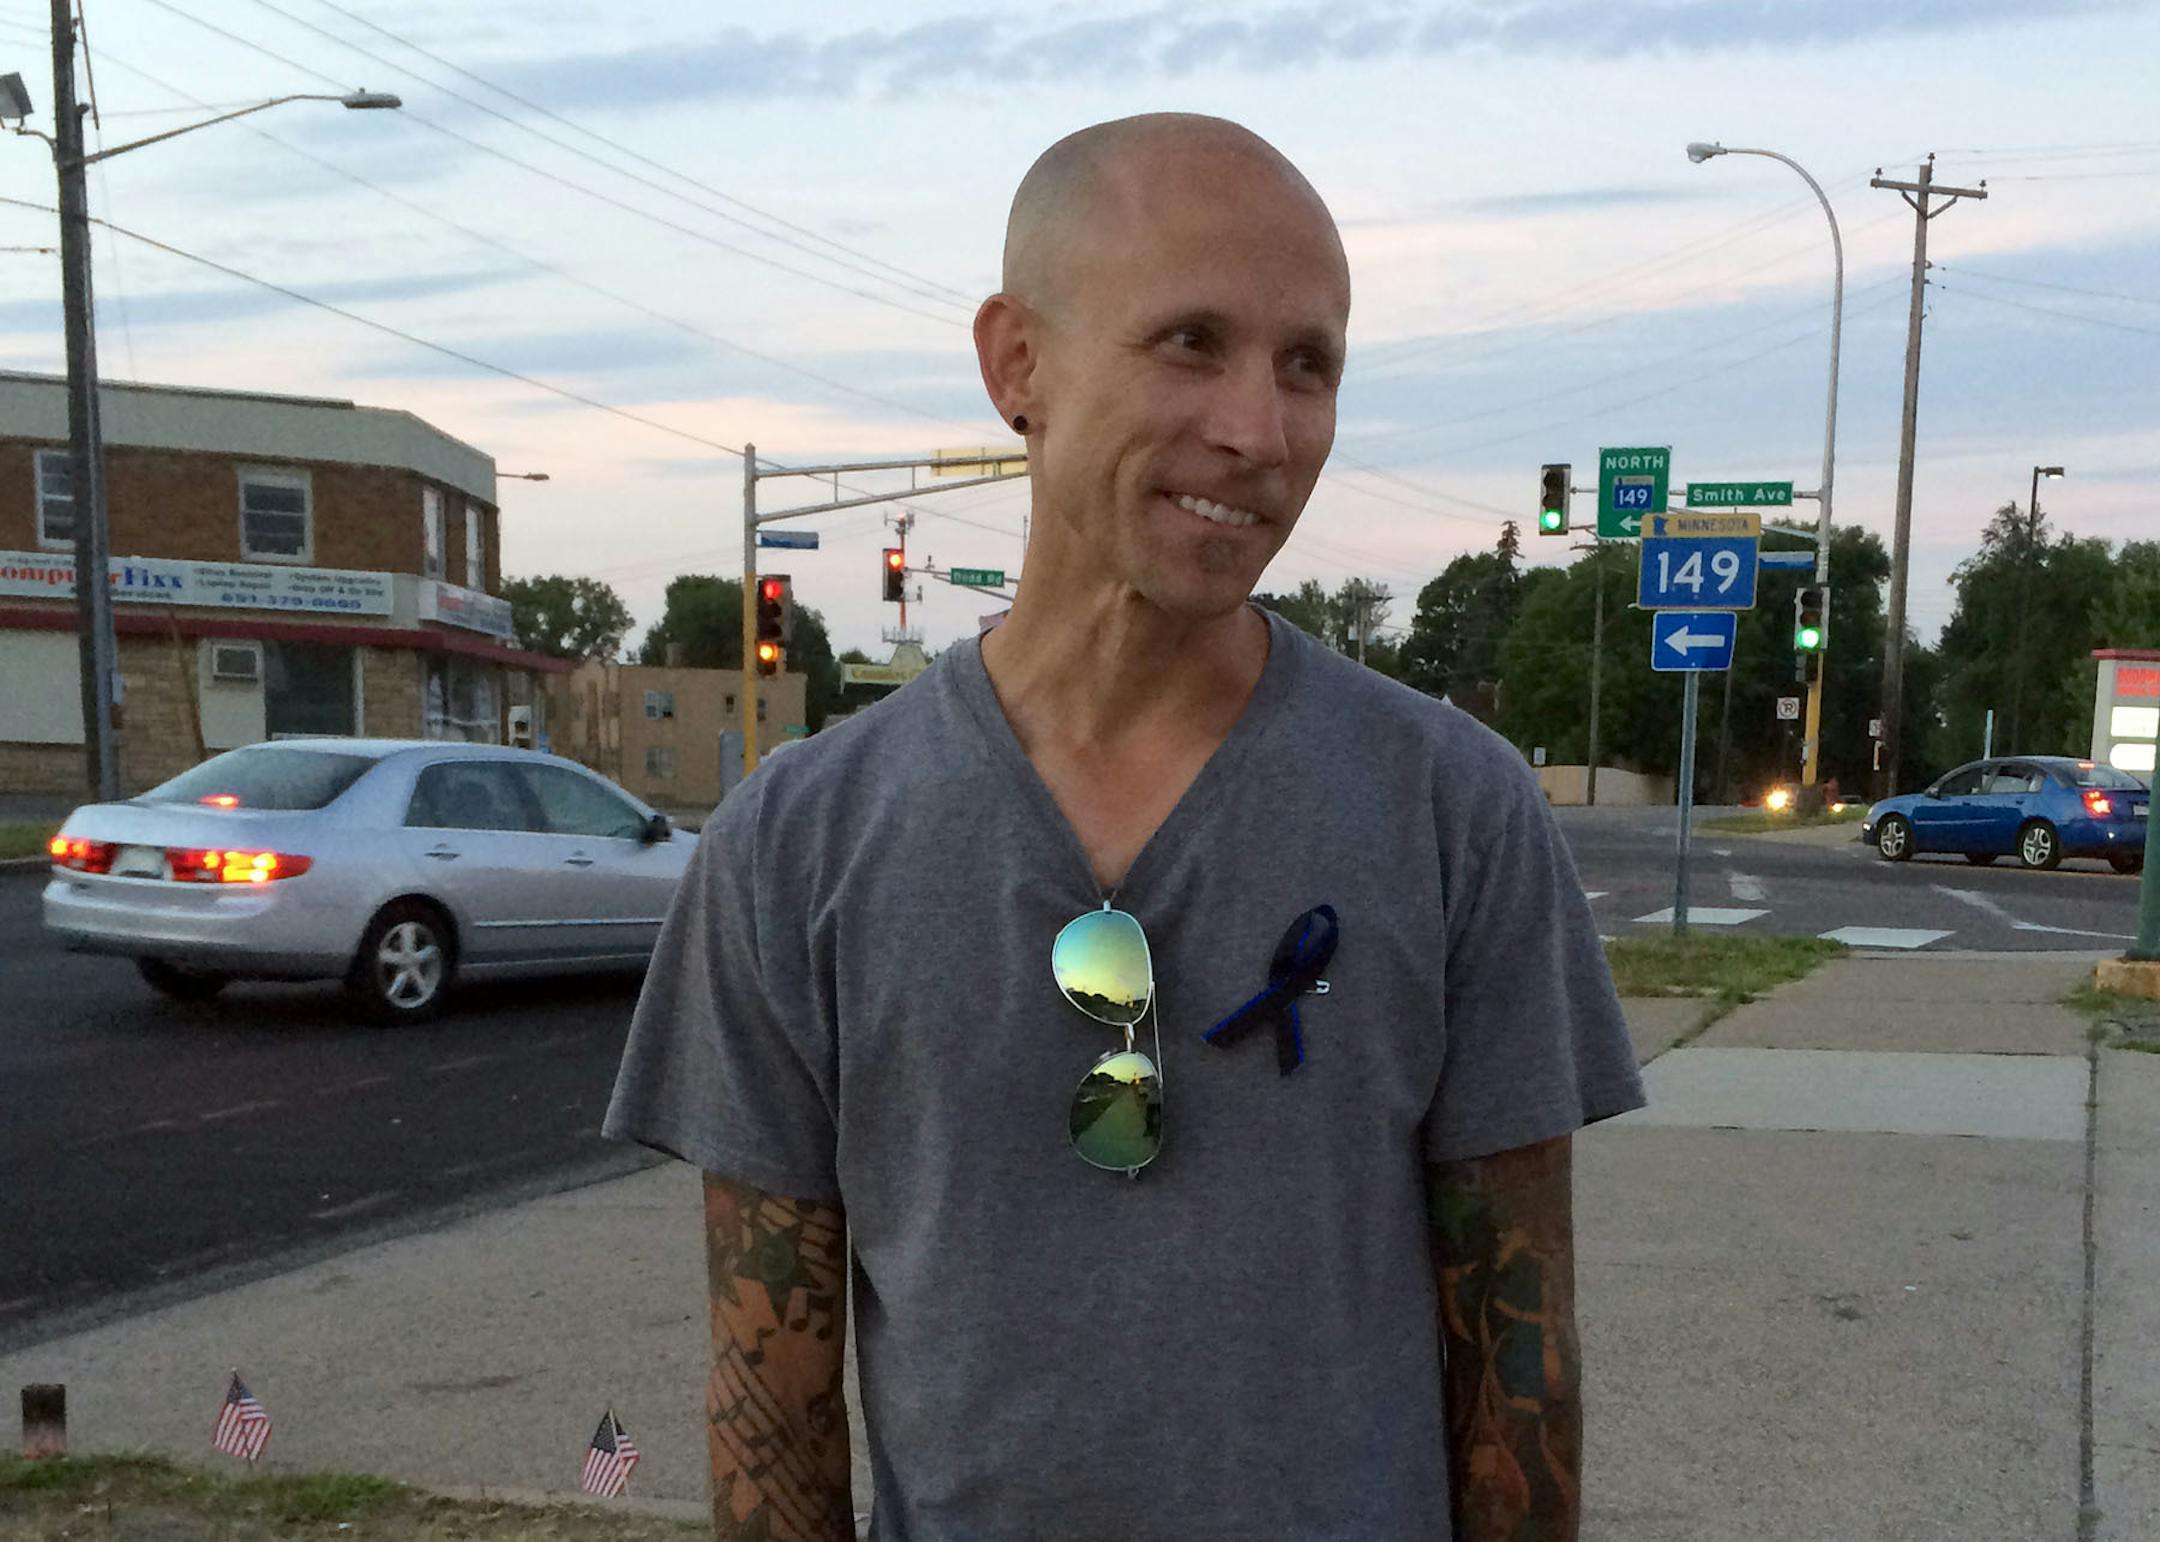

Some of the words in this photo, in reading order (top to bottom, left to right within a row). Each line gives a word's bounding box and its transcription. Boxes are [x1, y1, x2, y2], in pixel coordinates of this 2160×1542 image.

[1605, 455, 1664, 470] NORTH
[1619, 488, 1648, 505] 149
[1692, 488, 1745, 502] Smith
[1754, 488, 1787, 502] Ave
[1678, 518, 1749, 532] MINNESOTA
[1657, 549, 1740, 594] 149
